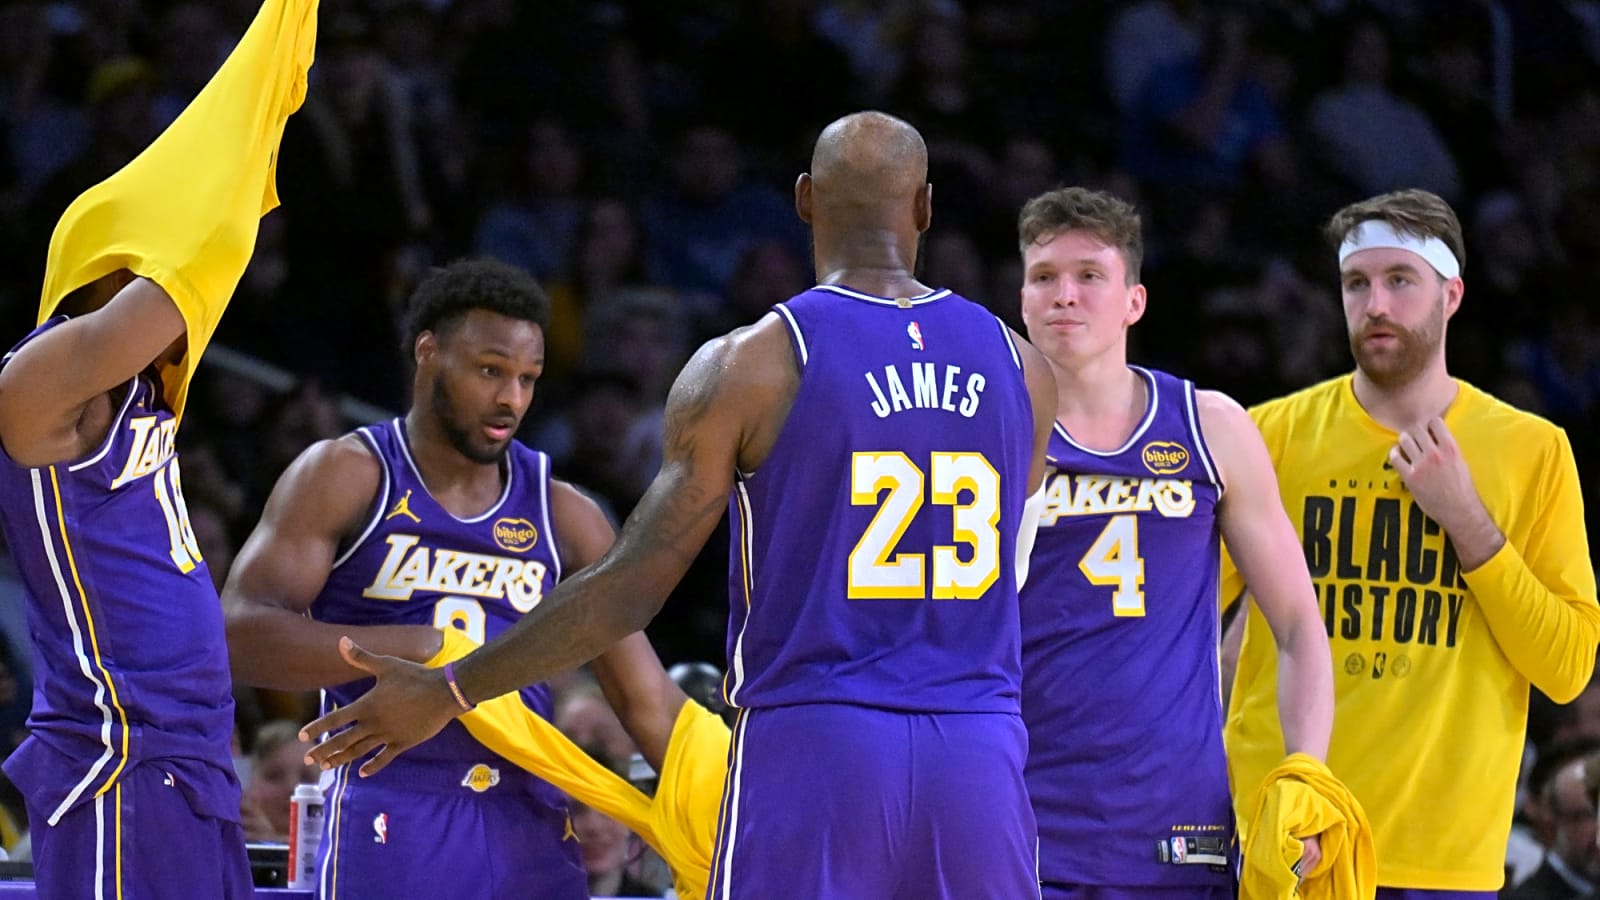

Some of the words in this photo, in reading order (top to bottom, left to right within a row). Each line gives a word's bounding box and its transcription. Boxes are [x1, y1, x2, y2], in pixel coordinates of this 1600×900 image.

[865, 362, 986, 418] JAMES
[1146, 450, 1185, 464] bibigo
[847, 451, 1000, 599] 23
[1038, 473, 1196, 527] AKERS
[497, 526, 534, 543] bibigo
[362, 533, 546, 614] LAKERS
[1078, 514, 1146, 617] 4
[1312, 583, 1464, 648] ISTORY
